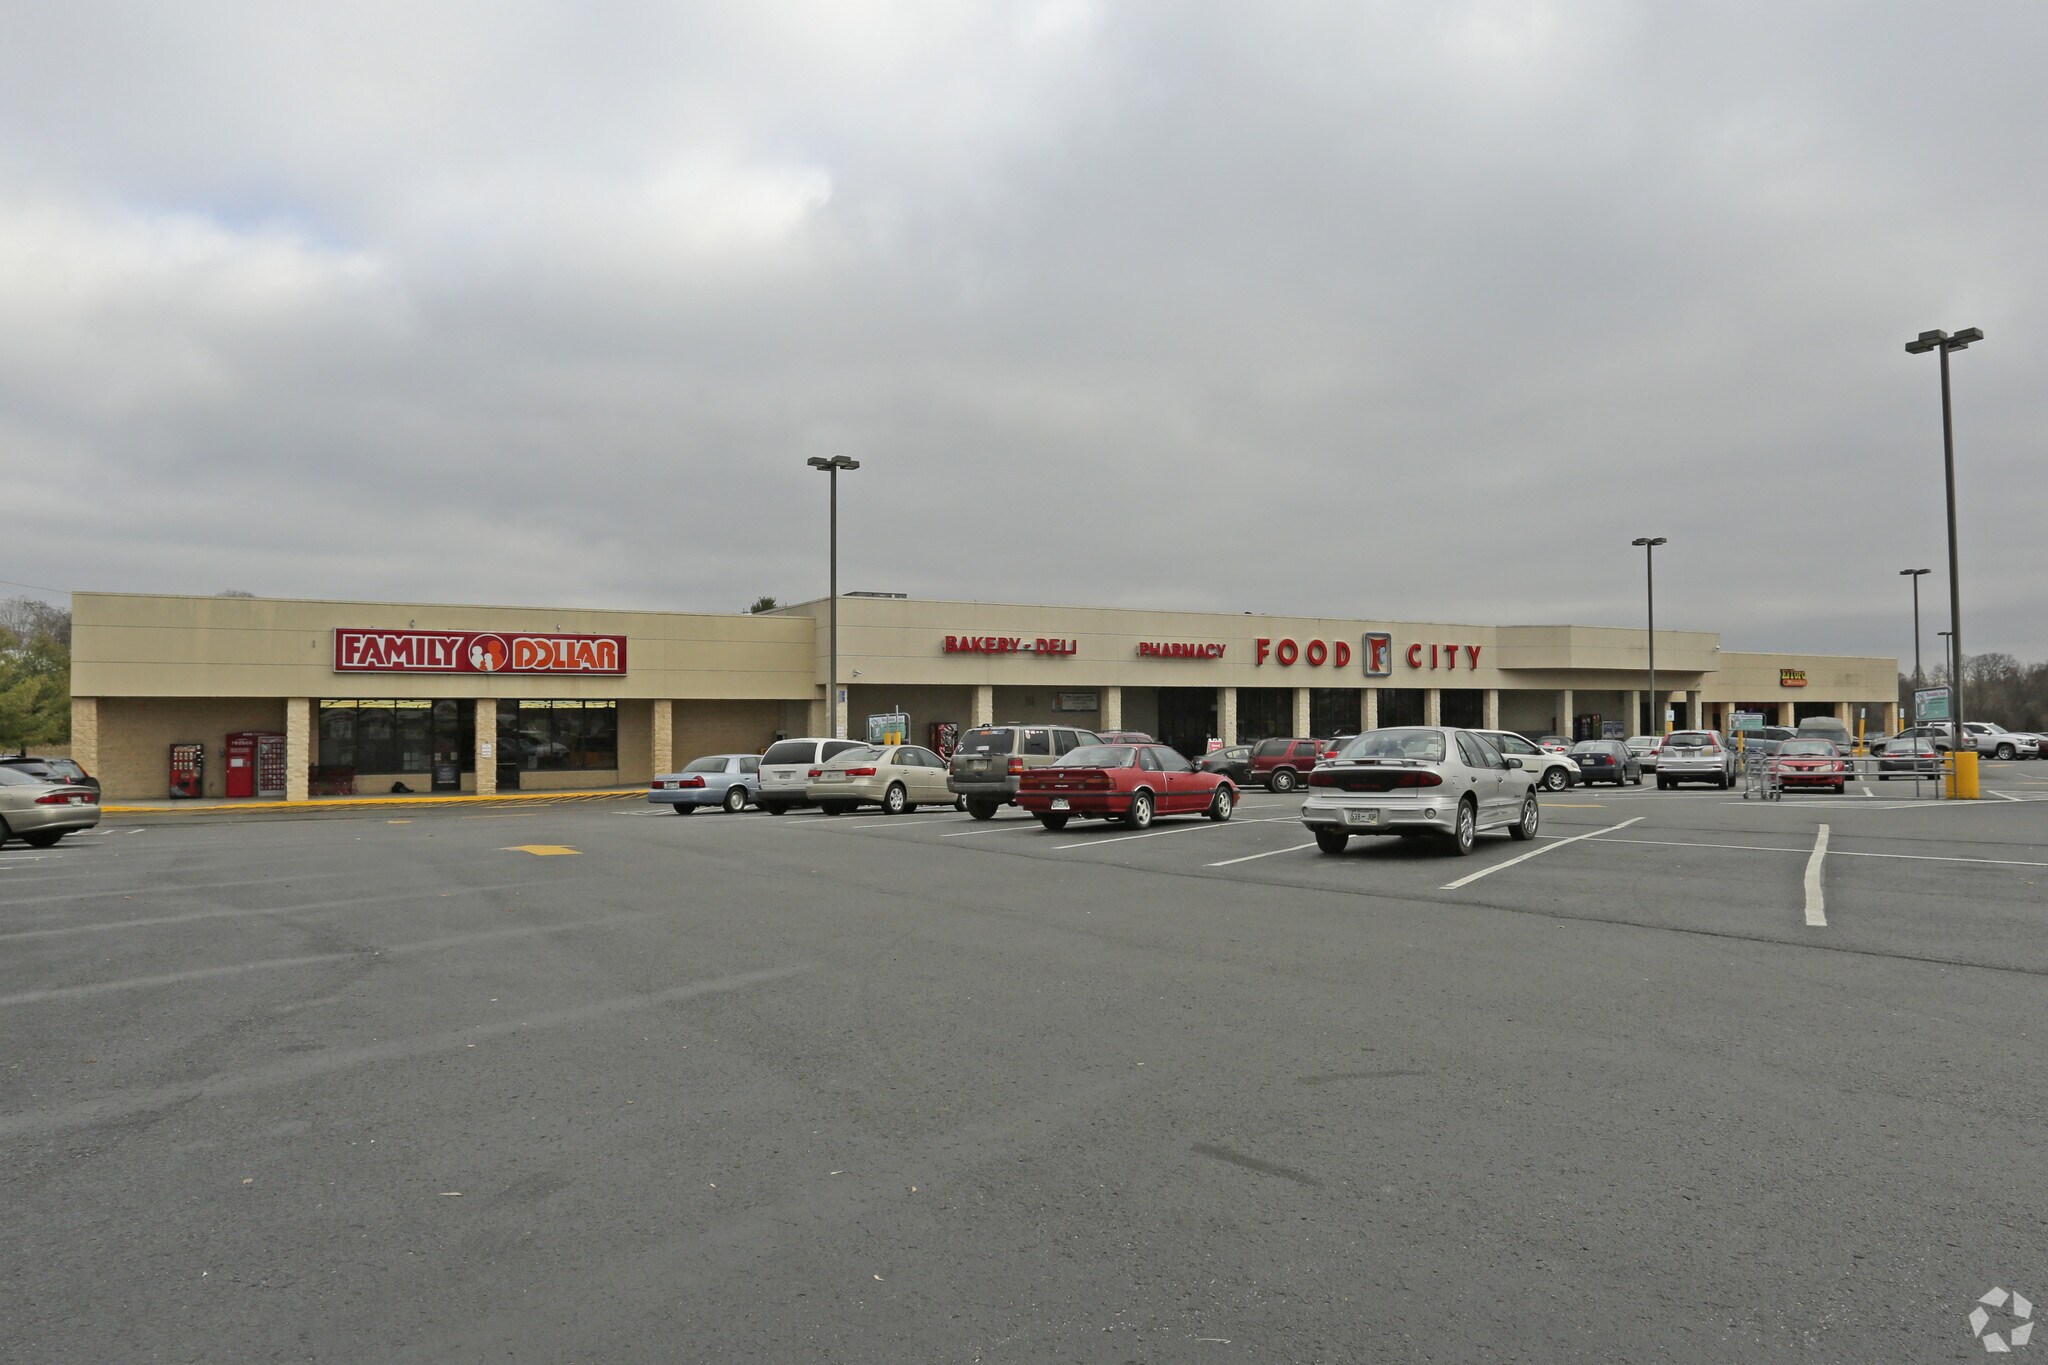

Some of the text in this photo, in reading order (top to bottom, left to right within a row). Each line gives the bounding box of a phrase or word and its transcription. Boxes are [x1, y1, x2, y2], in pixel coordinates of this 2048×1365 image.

[342, 634, 619, 675] FAMILY DOLLAR
[944, 635, 1021, 654] BAKERY
[1036, 638, 1077, 655] DELI
[1138, 641, 1227, 659] PHARMACY
[1255, 638, 1351, 668] FOOD
[1406, 642, 1482, 670] CITY
